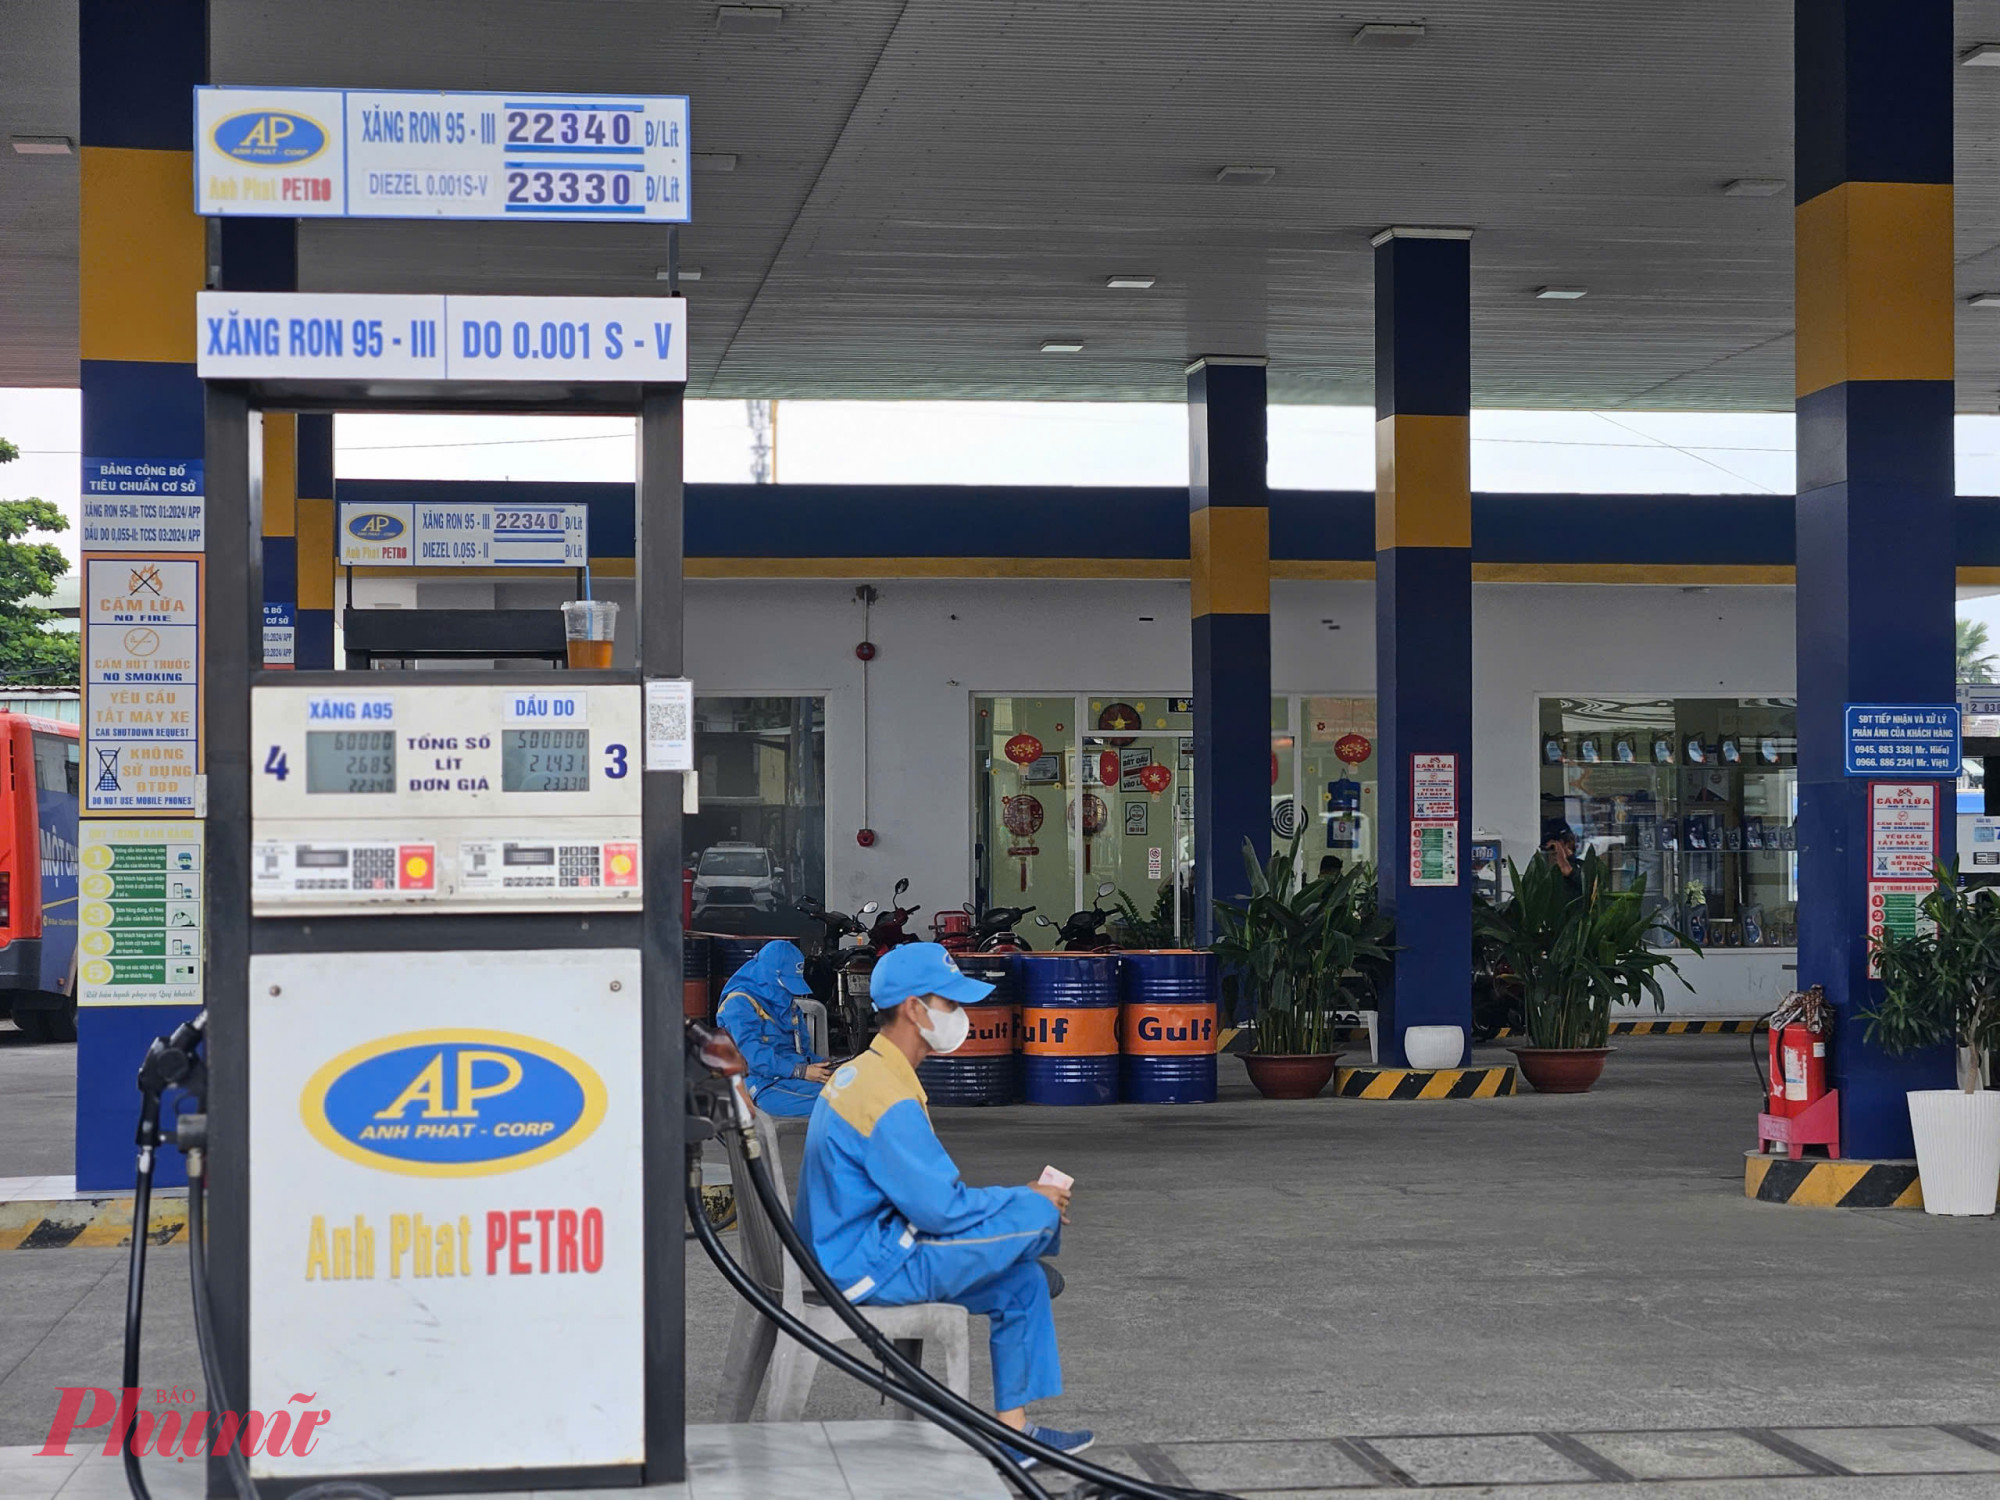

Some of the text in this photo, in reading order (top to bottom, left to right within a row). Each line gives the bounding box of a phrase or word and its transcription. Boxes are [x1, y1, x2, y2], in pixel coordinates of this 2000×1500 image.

[241, 117, 295, 146] AP
[362, 104, 404, 143] XĂNG
[409, 111, 440, 143] RON
[445, 112, 466, 144] 95
[481, 113, 496, 144] III
[507, 111, 631, 145] 22340
[645, 119, 679, 149] Đ/Lít
[231, 147, 252, 155] ANH
[209, 176, 332, 202] Anh Phat PETRO
[369, 172, 680, 204] DIEZEL 0.001S-V 23330 Đ/Lít
[207, 309, 280, 357] XĂNG
[289, 319, 342, 357] RON
[352, 320, 383, 358] 95
[411, 320, 436, 358] III
[463, 321, 501, 359] DO
[513, 321, 590, 360] 0.001
[605, 322, 623, 360] S
[655, 323, 672, 359] V
[100, 463, 186, 476] BẢNG CÔNG BỐ
[89, 478, 196, 493] TIÊU CHUẨN CƠ SỞ
[103, 505, 118, 518] RON
[140, 505, 157, 518] TCCS
[158, 505, 201, 519] 01:2024/APP
[361, 517, 389, 532] AP
[423, 510, 444, 530] XĂNG
[446, 513, 462, 530] RON
[464, 513, 475, 530] 95
[482, 513, 490, 530] III
[495, 512, 559, 530] 22340
[100, 528, 110, 541] DO
[140, 528, 157, 542] TCCS
[158, 528, 201, 542] 03:2024/APP
[382, 547, 407, 559] PETRO
[423, 542, 450, 558] DIEZEL
[453, 542, 476, 559] 0.05S
[483, 543, 489, 558] II
[100, 595, 185, 612] CẤM LỬA
[271, 605, 282, 614] BỐ
[114, 614, 172, 622] NO FIRE
[95, 656, 122, 670] CẤM
[103, 672, 183, 682] NO SMOKING
[110, 689, 176, 704] YÊU CẦU
[309, 696, 393, 720] XĂNG A95
[515, 694, 575, 717] DẦU DO
[95, 706, 190, 723] TẮT MÁY XE
[1875, 712, 1891, 724] TIẾP
[1893, 714, 1913, 725] NHẬN
[1915, 712, 1924, 724] VÀ
[1926, 712, 1937, 724] XỬ
[1937, 714, 1947, 724] LÝ
[95, 728, 190, 738] CAR SHUTDOWN REQUEST
[1853, 726, 1953, 738] PHẢN ÁNH CỦA KHÁCH HÀNG
[335, 732, 392, 750] 60000
[406, 732, 491, 750] TỔNG SỐ
[518, 731, 586, 749] 500000
[130, 746, 185, 760] KHÔNG
[1855, 745, 1877, 754] 0945.
[1879, 745, 1894, 754] 883
[1915, 746, 1928, 754] Mr.
[264, 745, 290, 781] 4
[435, 756, 463, 771] LÍT
[604, 744, 628, 779] 3
[1856, 758, 1878, 767] 0966.
[1879, 758, 1895, 767] 886
[1916, 759, 1930, 767] Mr.
[1931, 758, 1949, 768] Việt)
[122, 762, 192, 780] SỬ DỤNG
[350, 779, 393, 793] 22340
[409, 775, 490, 791] ĐƠN GIÁ
[544, 777, 586, 791] 23330
[92, 797, 192, 805] DO NOT USE MOBILE PHONES
[1908, 797, 1931, 805] LỬA
[1338, 822, 1346, 833] 6
[1874, 912, 1881, 920] 2
[1023, 1018, 1069, 1043] ulf
[1138, 1016, 1212, 1041] Gulf
[374, 1050, 523, 1119] AP
[359, 1124, 408, 1139] ANH
[414, 1123, 476, 1138] PHAT
[494, 1122, 554, 1137] CORP
[305, 1206, 604, 1281] Anh Phat PETRO
